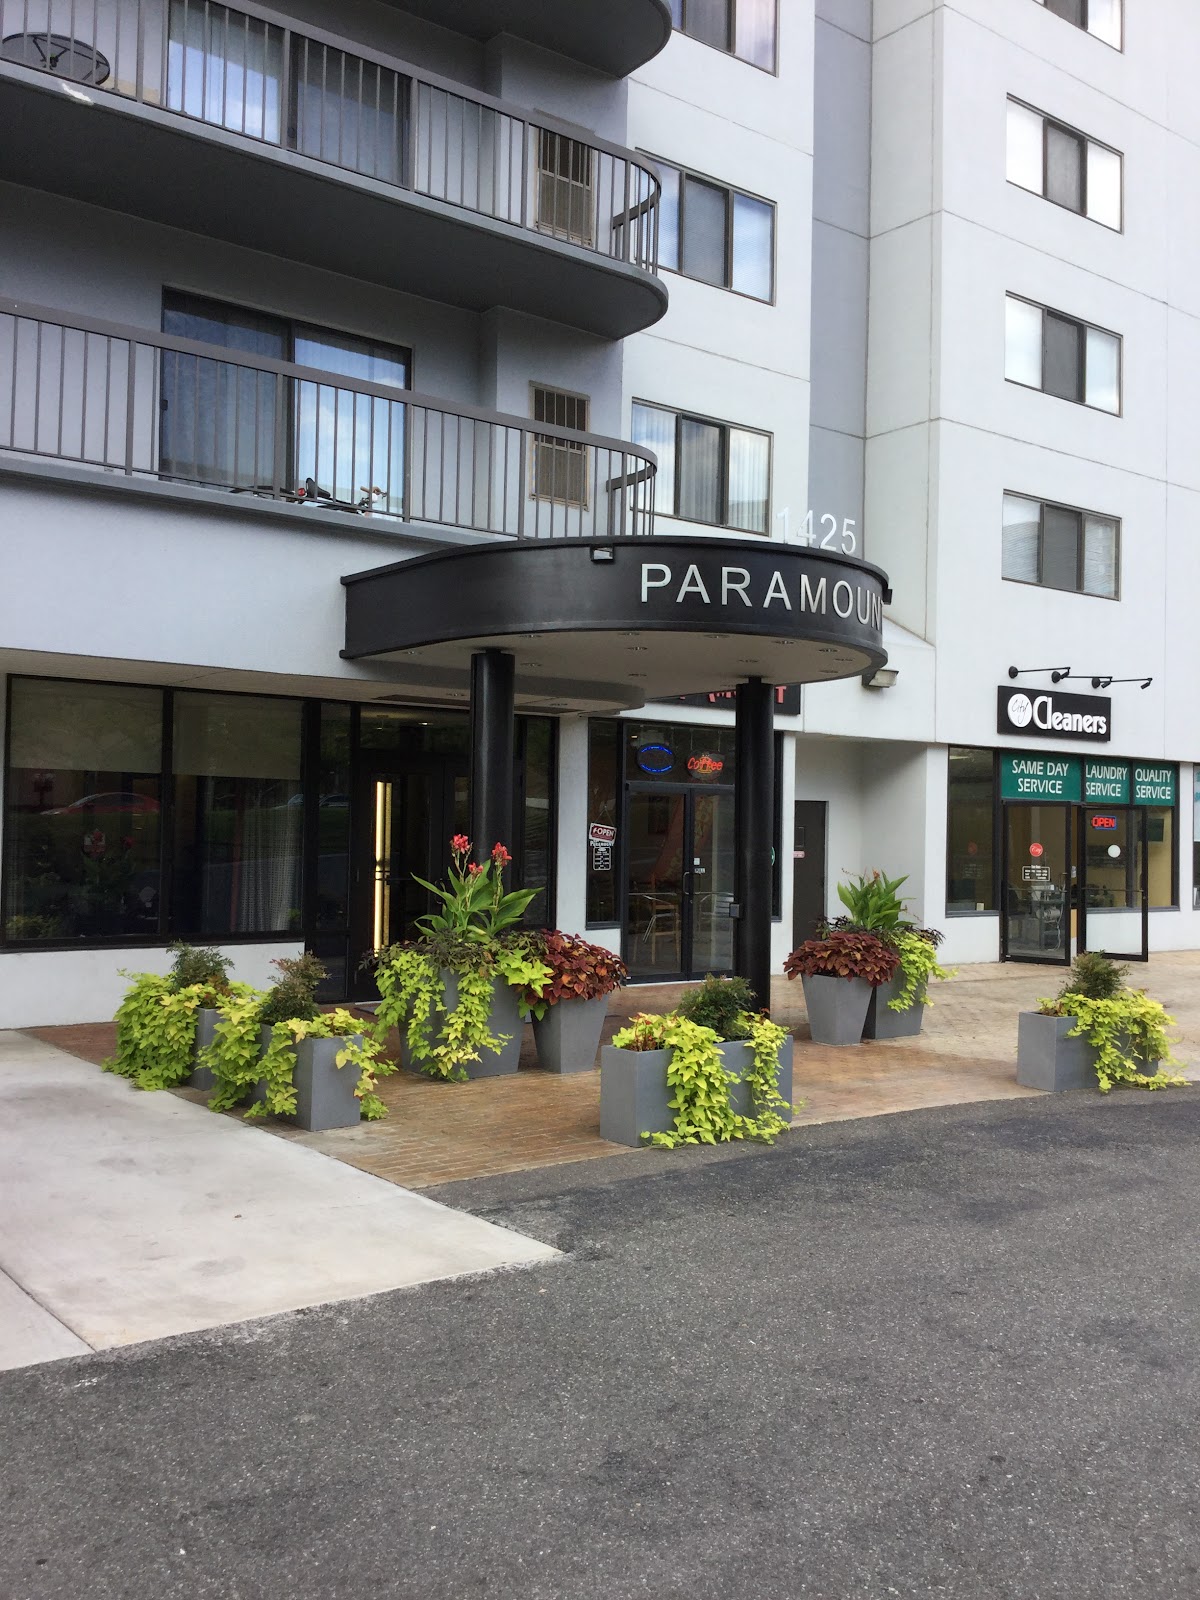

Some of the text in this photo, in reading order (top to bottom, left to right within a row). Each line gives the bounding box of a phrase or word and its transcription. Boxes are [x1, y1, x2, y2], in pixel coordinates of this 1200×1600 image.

[776, 507, 857, 555] 1425
[1011, 695, 1107, 735] City Cleaners
[687, 756, 723, 770] Coffee
[1012, 759, 1069, 777] SAME DAY
[1085, 764, 1128, 780] LAUNDRY
[1135, 768, 1172, 783] QUALITY
[1017, 778, 1062, 794] SERVICE
[1085, 781, 1121, 797] SERVICE
[1136, 784, 1171, 799] SERVICE
[1092, 817, 1115, 828] OPEN
[597, 827, 615, 837] OPEN
